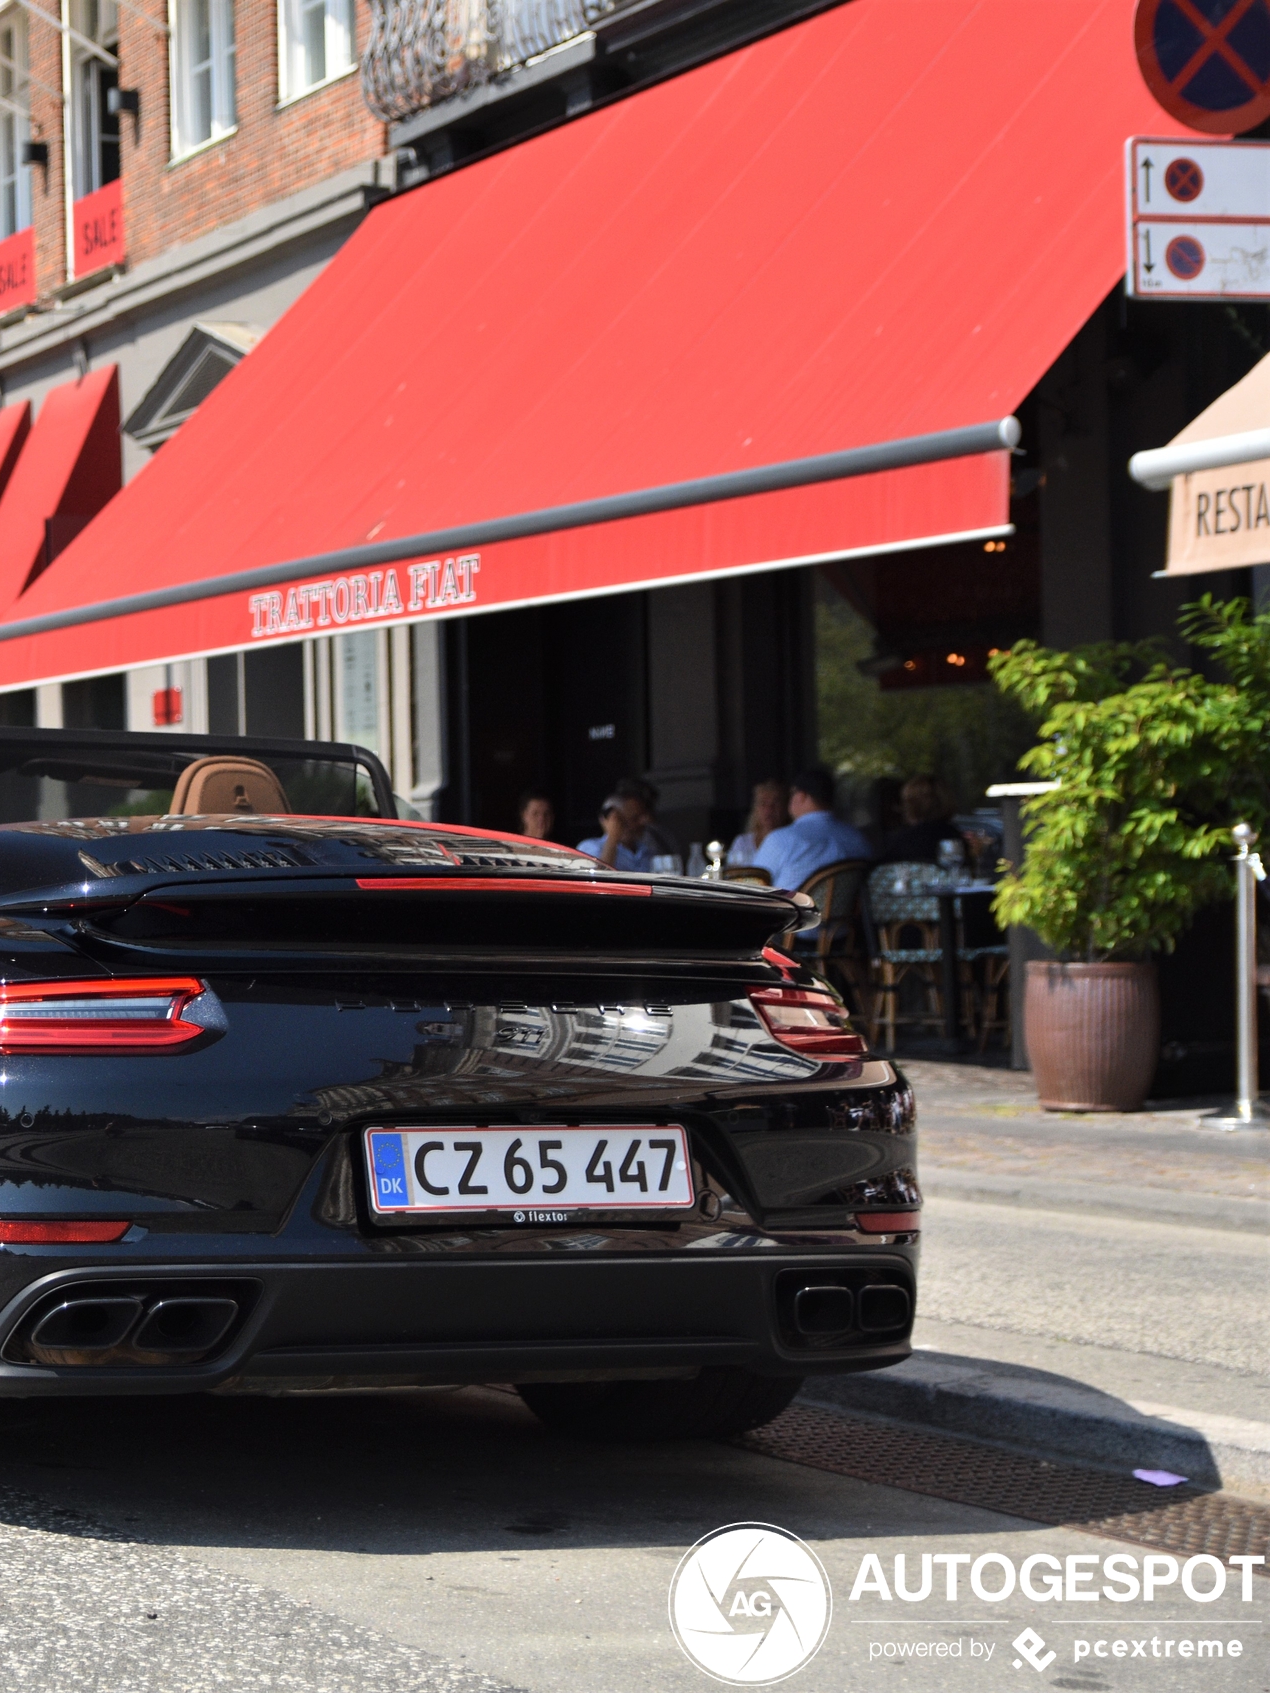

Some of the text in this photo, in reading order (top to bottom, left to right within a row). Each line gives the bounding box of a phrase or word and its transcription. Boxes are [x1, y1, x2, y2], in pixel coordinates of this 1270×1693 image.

[83, 207, 118, 255] SALE
[1196, 482, 1270, 538] RESTA
[249, 553, 480, 637] TRATTORIA FIAT
[496, 1026, 549, 1044] 911
[381, 1177, 404, 1194] DK
[414, 1137, 676, 1195] CZ 65 447
